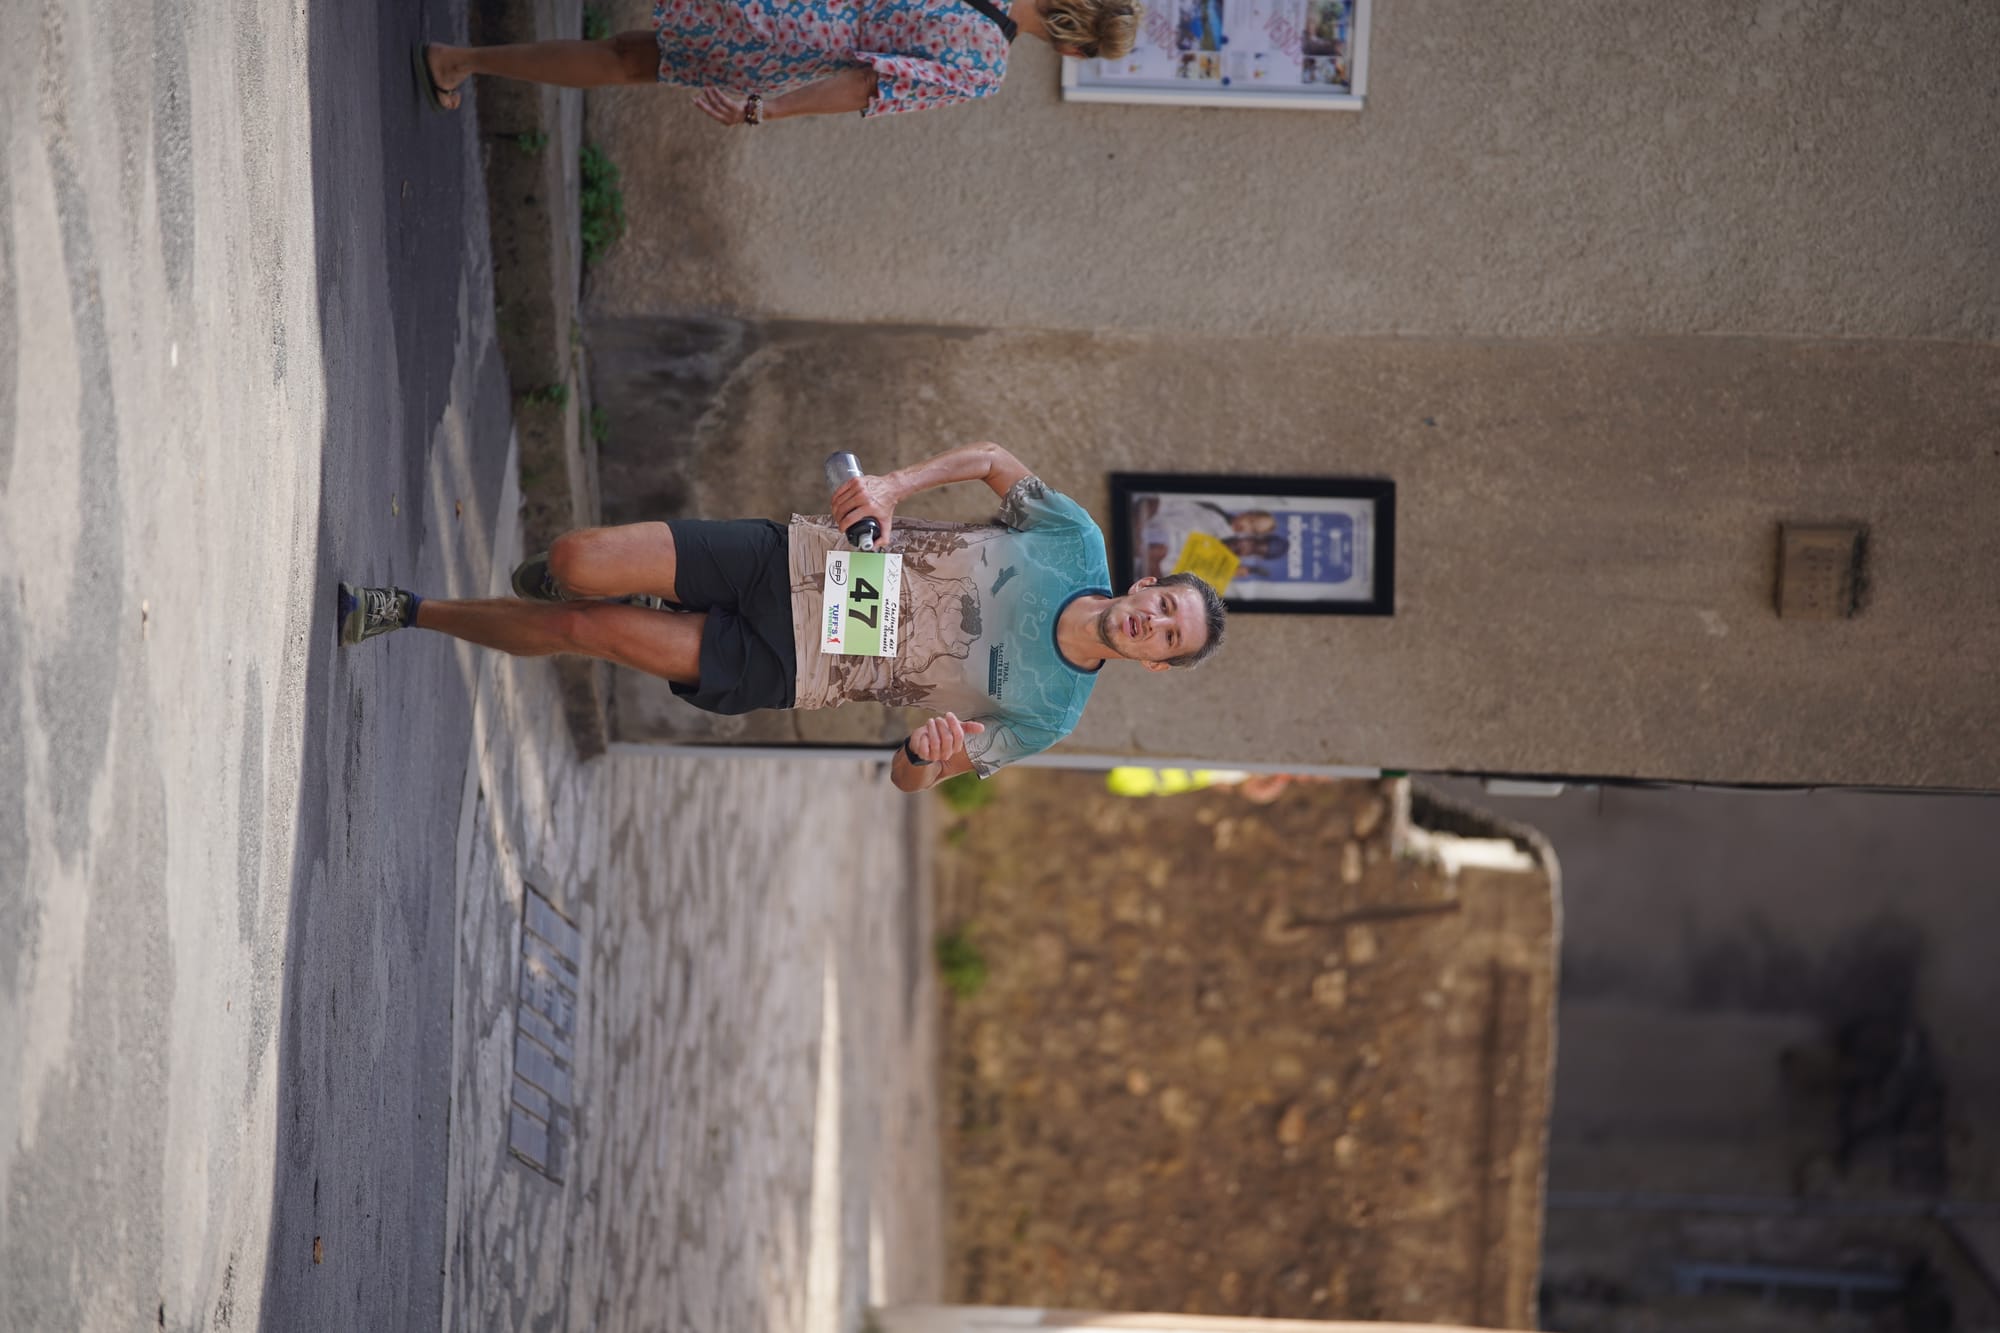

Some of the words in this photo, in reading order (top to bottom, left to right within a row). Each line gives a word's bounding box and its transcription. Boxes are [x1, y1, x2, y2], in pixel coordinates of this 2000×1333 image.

[832, 604, 840, 635] TUFF'S
[848, 578, 880, 628] 47
[887, 602, 897, 635] Challenge
